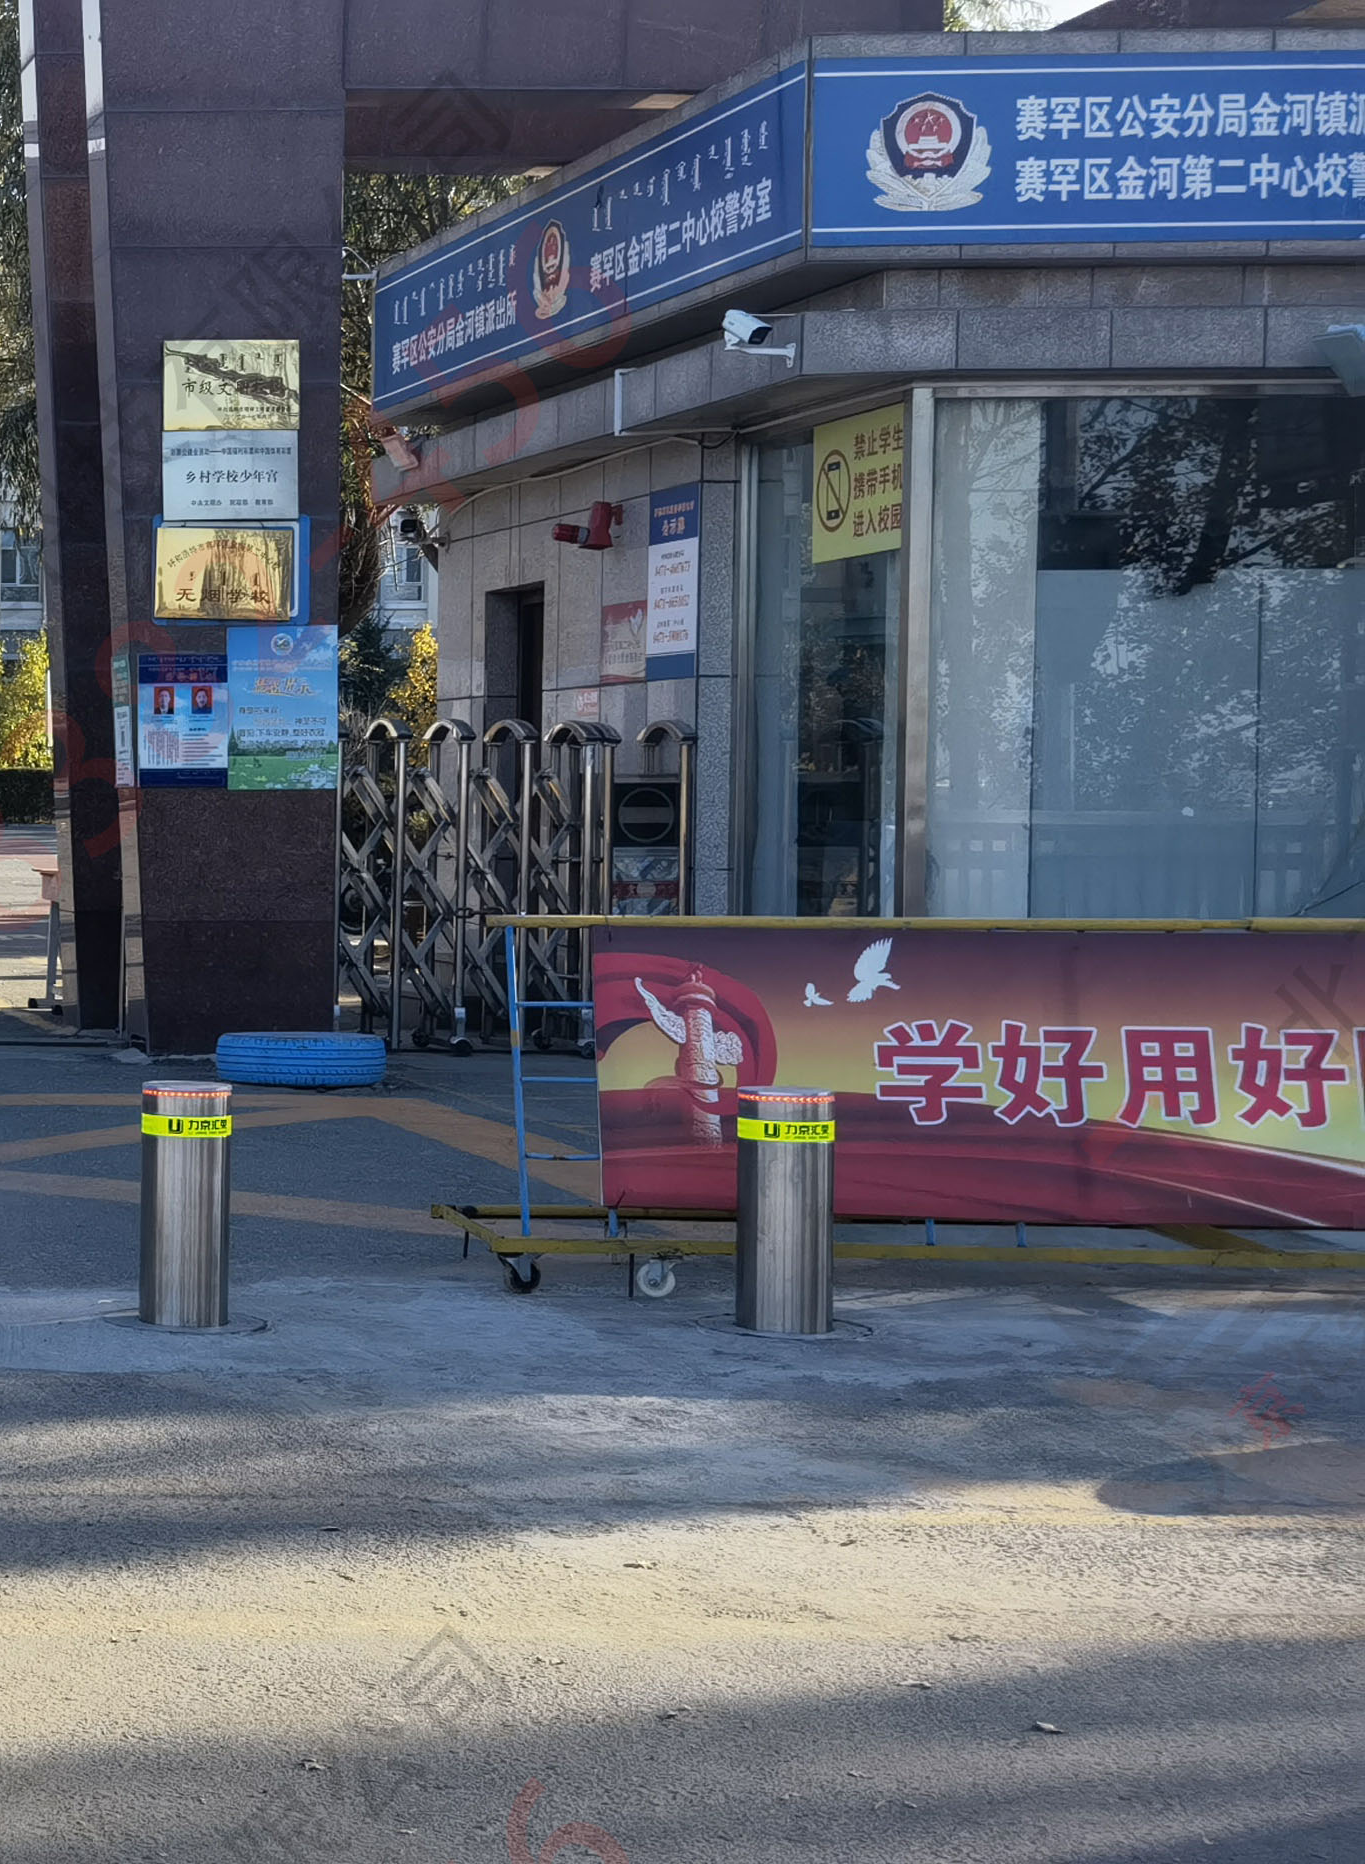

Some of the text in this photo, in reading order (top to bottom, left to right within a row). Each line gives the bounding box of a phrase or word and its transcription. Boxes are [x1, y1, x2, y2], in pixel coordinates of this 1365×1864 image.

[588, 177, 773, 293] 赛罕区金河第二中心校警务室
[391, 289, 518, 375] 赛罕区公安分局金河镇派出所
[853, 424, 904, 461] 禁止学生
[185, 468, 279, 484] 乡村学校少年宫
[853, 463, 903, 500] 携带手机
[852, 502, 902, 538] 进入校园
[175, 588, 271, 604] 无烟学校
[873, 1018, 1365, 1129] 学好用好
